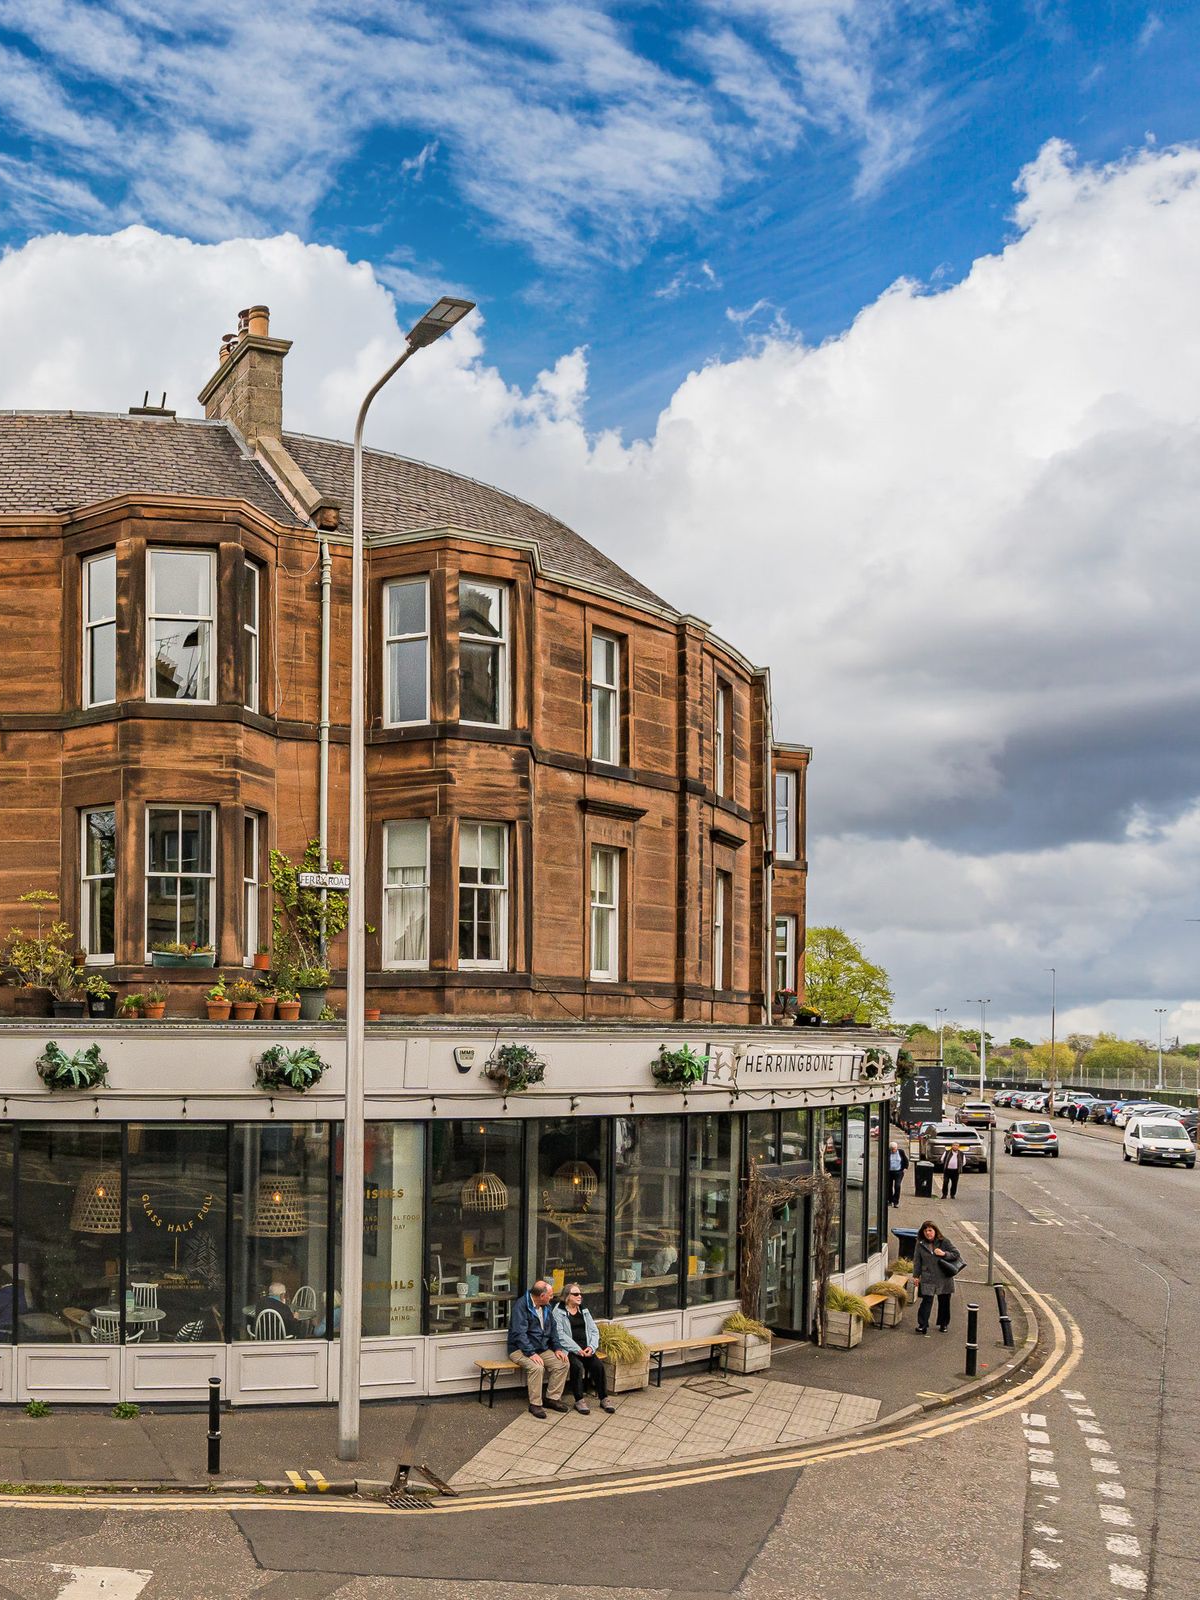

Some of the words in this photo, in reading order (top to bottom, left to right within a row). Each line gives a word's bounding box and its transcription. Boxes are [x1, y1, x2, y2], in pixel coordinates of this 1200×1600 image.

[328, 876, 350, 886] ROAD
[745, 1055, 834, 1073] HERRINGBONE
[366, 1188, 404, 1199] ISHES
[142, 1194, 162, 1226] GLASS
[167, 1220, 194, 1232] HALF
[197, 1194, 213, 1220] FULL
